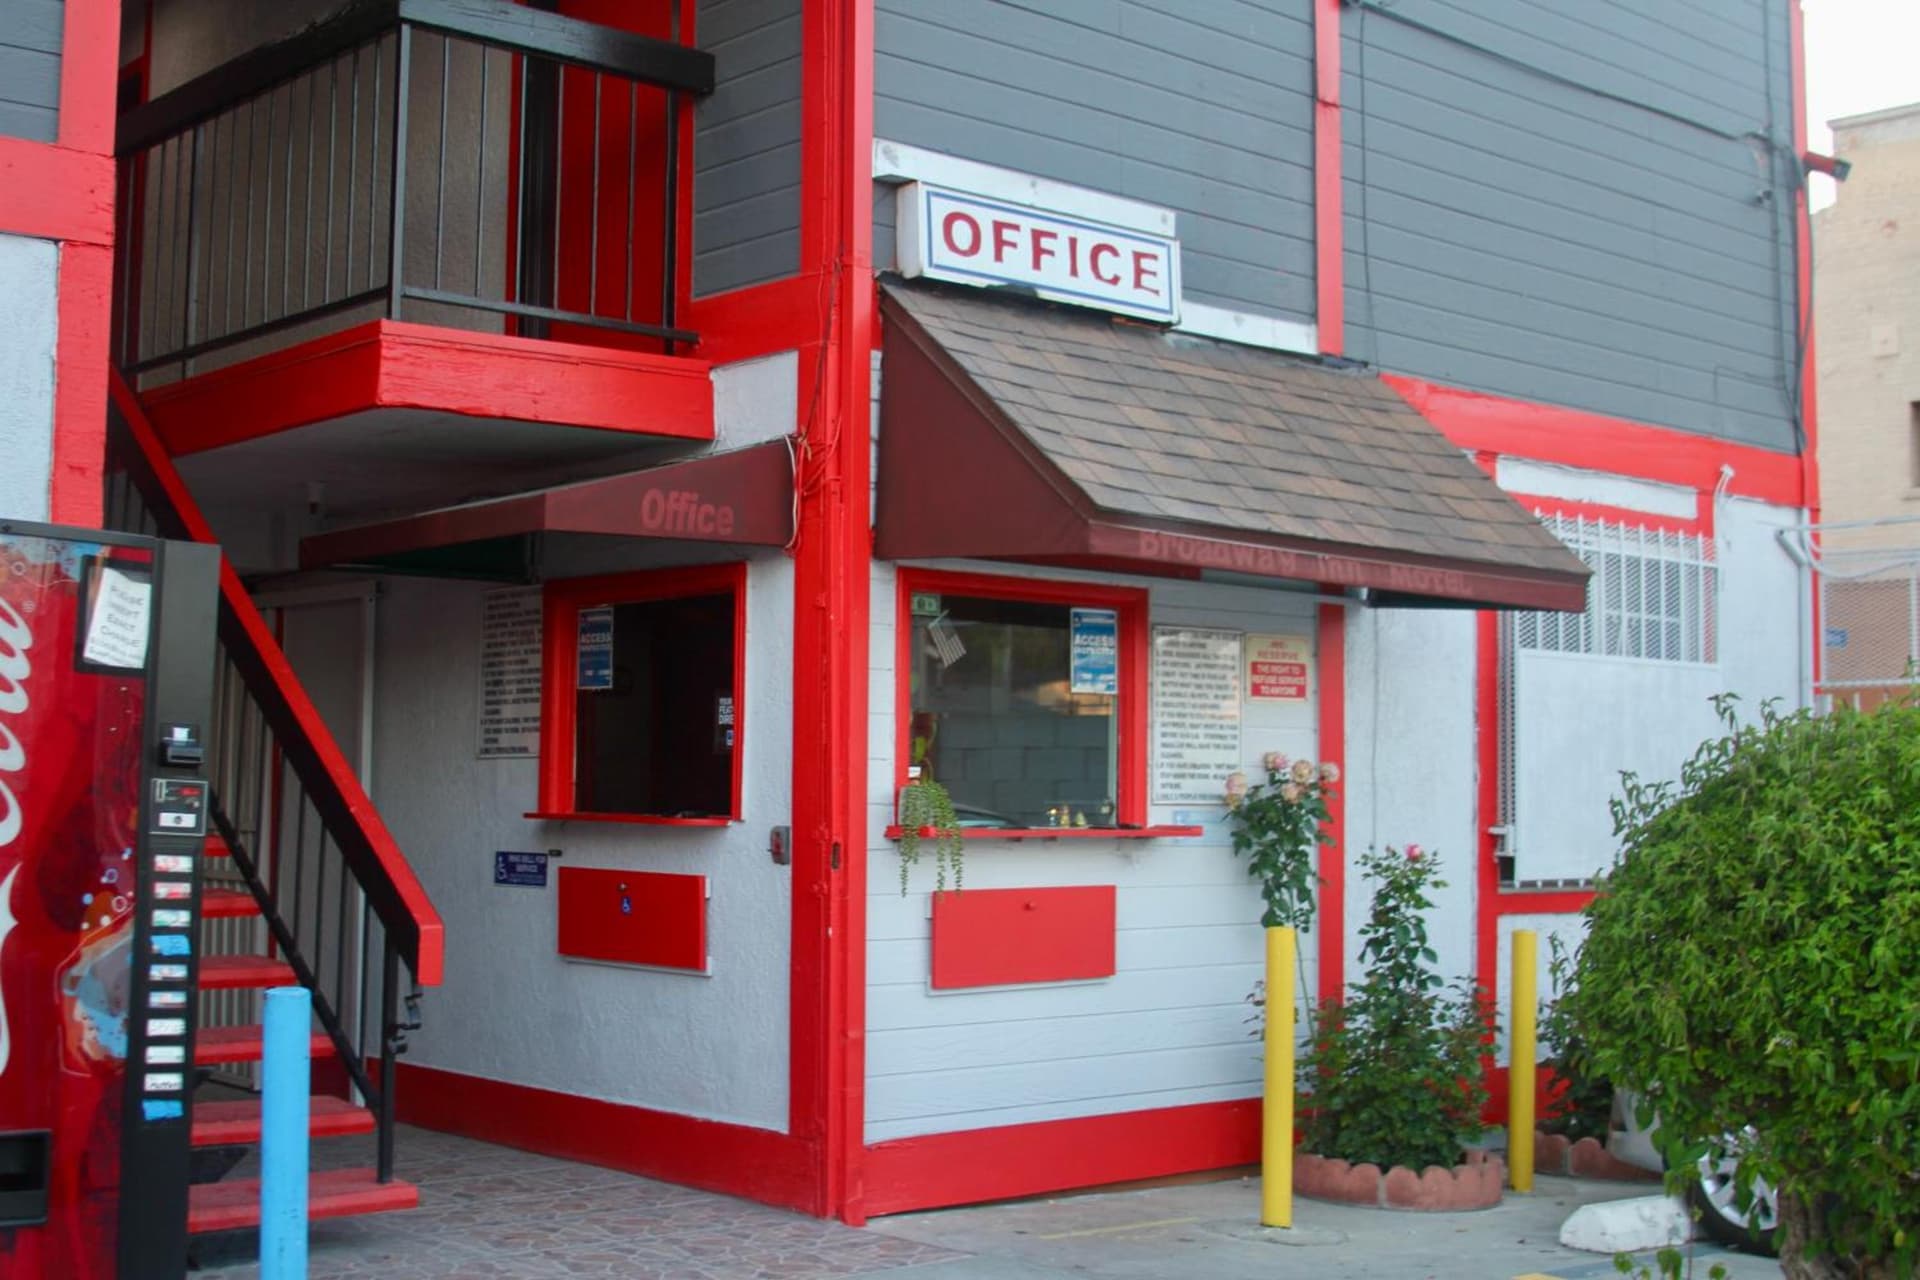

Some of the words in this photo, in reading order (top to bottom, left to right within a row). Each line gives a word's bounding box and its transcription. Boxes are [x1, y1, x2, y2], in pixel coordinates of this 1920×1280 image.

[943, 211, 1160, 296] OFFICE
[642, 488, 734, 536] Office
[1139, 531, 1297, 574] Broadway
[1074, 634, 1114, 647] ACCESS
